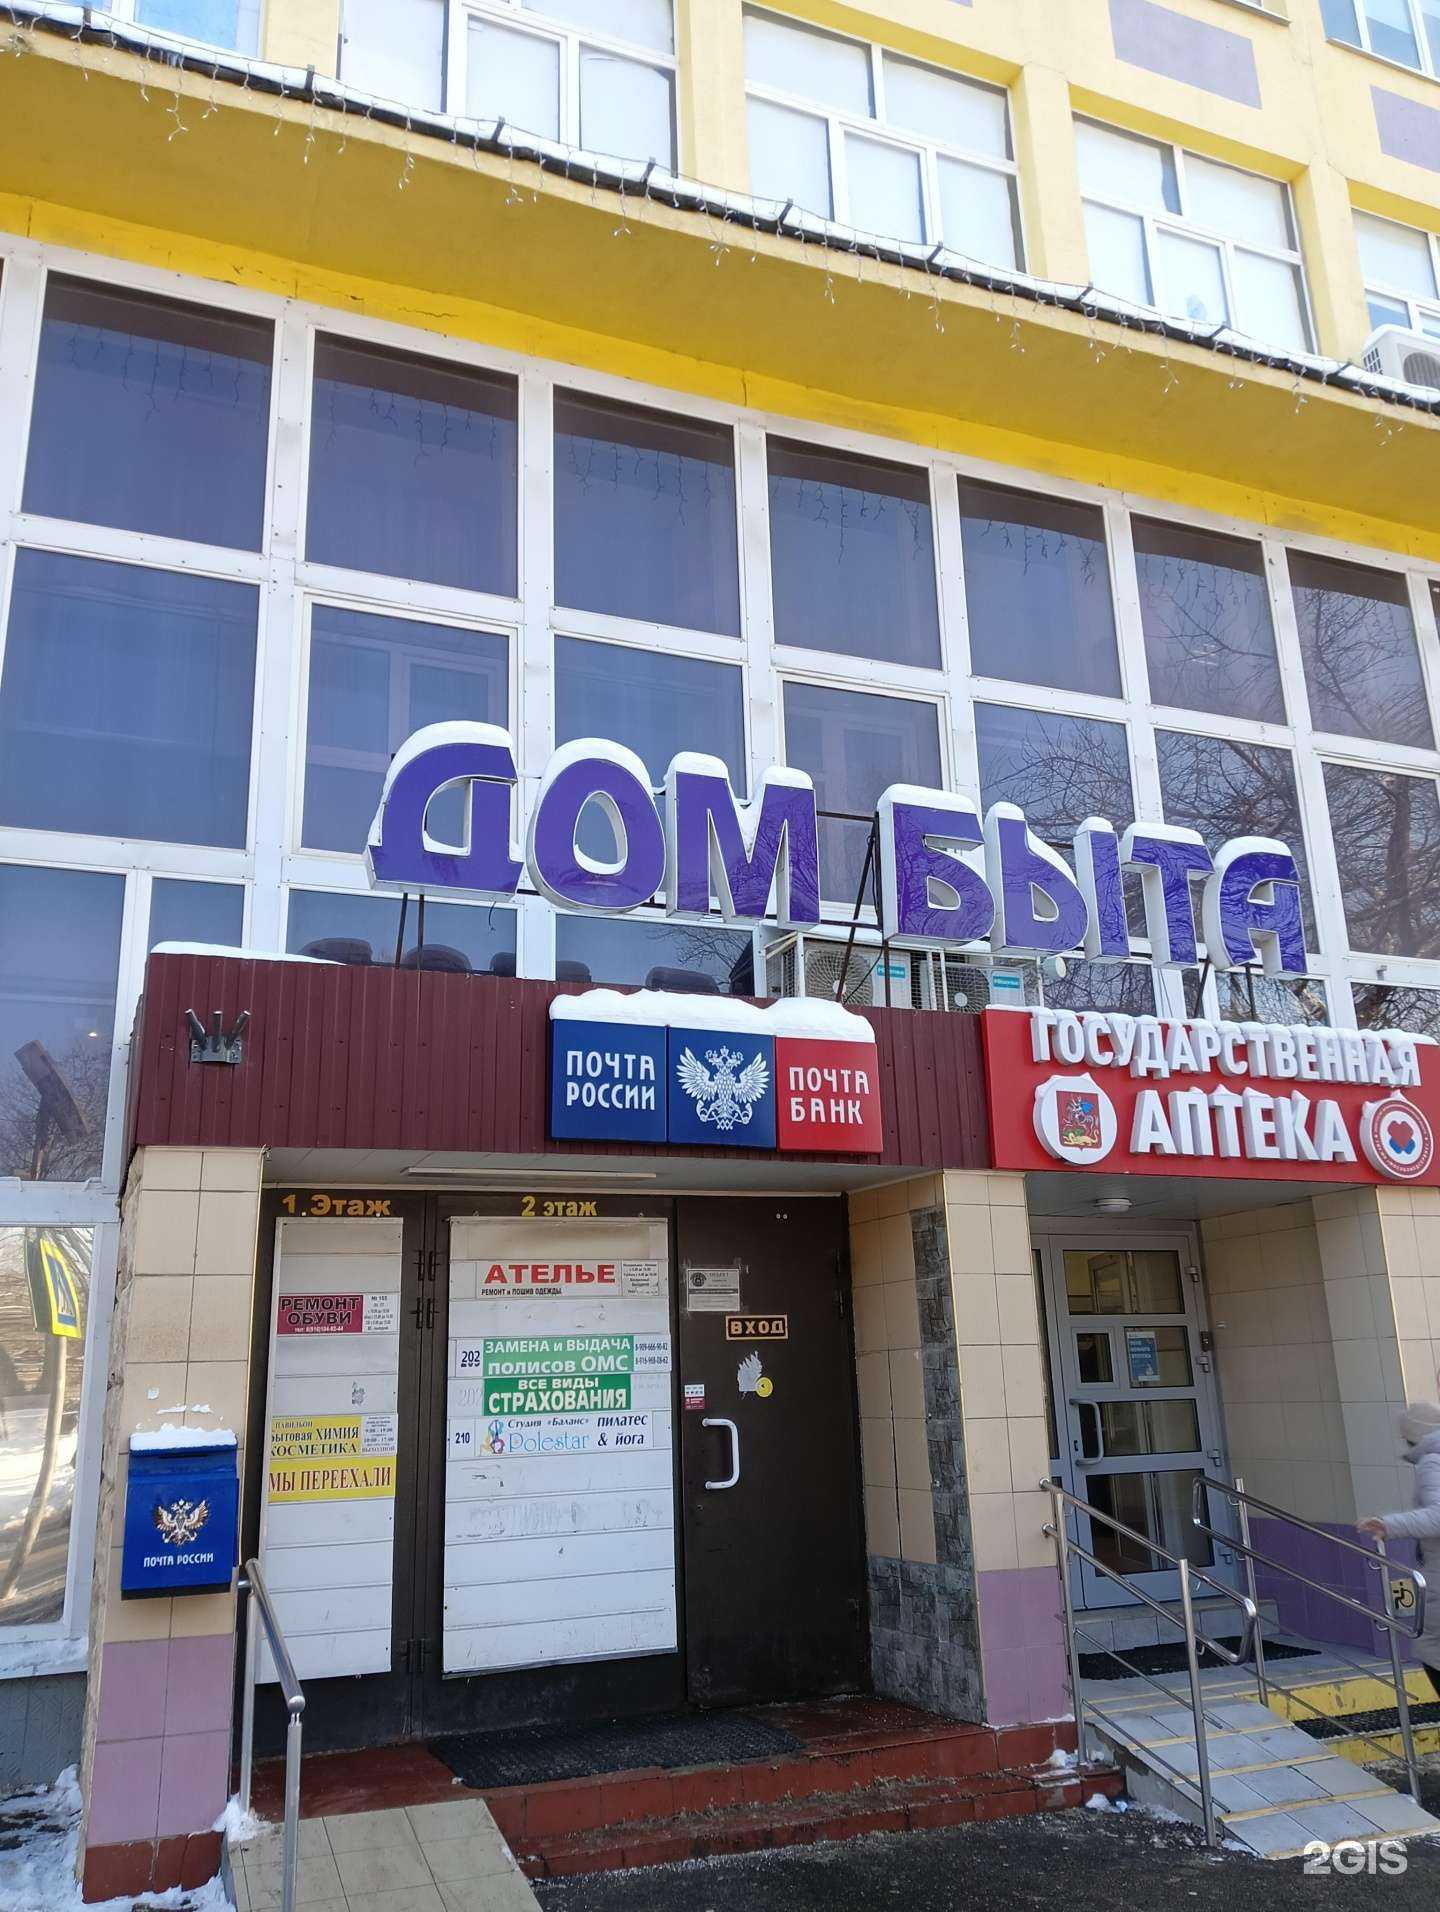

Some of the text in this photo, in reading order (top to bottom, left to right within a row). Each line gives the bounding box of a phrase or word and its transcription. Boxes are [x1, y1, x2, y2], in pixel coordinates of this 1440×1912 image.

[366, 732, 1308, 976] ДОМ БЫТА
[1031, 1014, 1421, 1087] ГОСУДАРСТВЕННАЯ
[566, 1050, 656, 1081] ПОЧТА
[789, 1066, 869, 1095] ПОЧТА
[566, 1082, 656, 1110] РОССИИ
[790, 1097, 863, 1125] БАНК
[1130, 1087, 1358, 1163] АПТЕКА
[521, 1195, 597, 1217] 2 этаж
[484, 1264, 616, 1284] АТЕЛЬЕ
[481, 1287, 505, 1296] РЕМОНТ
[535, 1287, 562, 1296] ОДЕЖДЫ
[280, 1296, 360, 1311] РЕМОНТ
[287, 1310, 352, 1326] ОБУВИ
[730, 1319, 785, 1335] ВХОД
[485, 1337, 631, 1354] ЗАМЕНА и ВЫДАЧА
[461, 1350, 480, 1363] 202
[581, 1354, 629, 1372] ОМС
[518, 1377, 599, 1391] ВСЕ ВИДЫ
[488, 1388, 627, 1414] СТРАХОВАНИЯ
[508, 1418, 542, 1429] Студия
[597, 1414, 648, 1427] пилатес
[316, 1426, 359, 1441] ХИМИЯ
[455, 1432, 471, 1444] 210
[509, 1431, 591, 1453] Polestar
[597, 1432, 645, 1447] & йога
[268, 1466, 391, 1492] МЫ ПЕРЕЕХАЛИ
[143, 1552, 214, 1568] ПОЧТА РОССИИ
